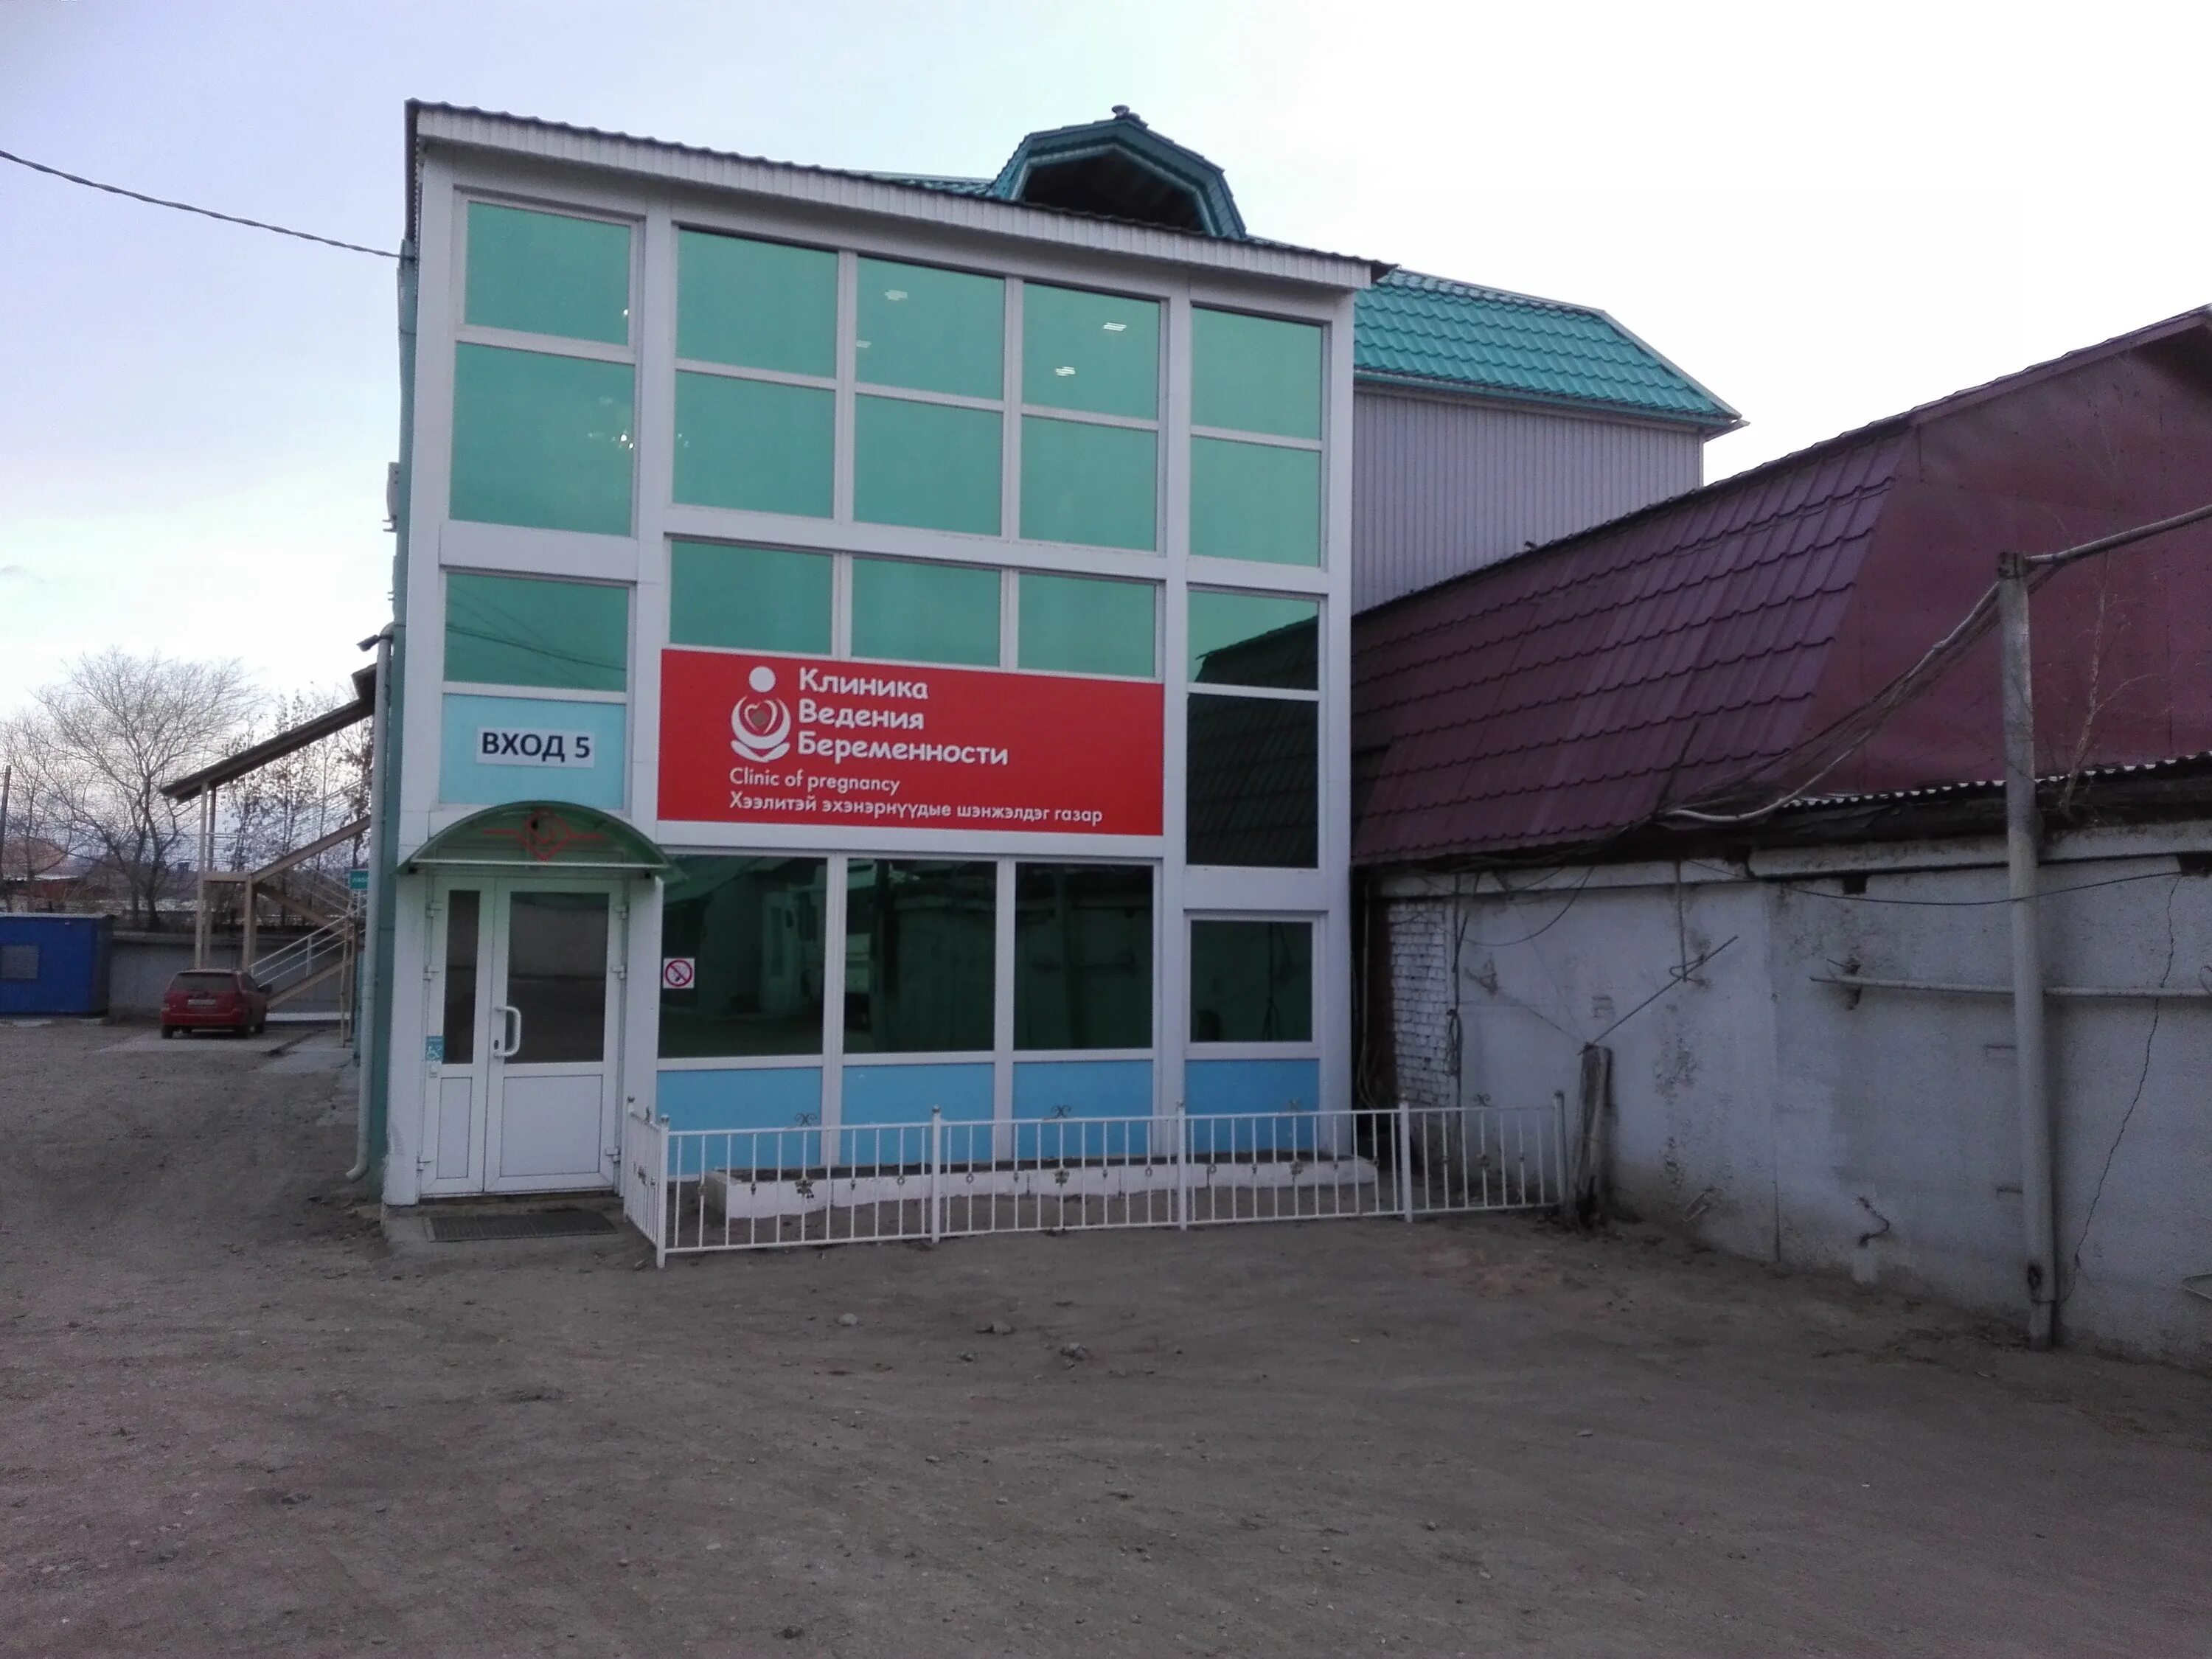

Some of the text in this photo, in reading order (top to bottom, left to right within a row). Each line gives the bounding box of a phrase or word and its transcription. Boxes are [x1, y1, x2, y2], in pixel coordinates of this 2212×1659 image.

[799, 667, 929, 700] Клиника
[799, 698, 925, 730] Ведения
[481, 731, 591, 762] ВХОД 5
[797, 730, 1009, 765] Беременности
[729, 767, 901, 796] Clinic of pregnancy
[729, 790, 817, 812] Хээлитэй
[956, 804, 1051, 822] шэнжэлдэг
[1054, 809, 1103, 827] газар
